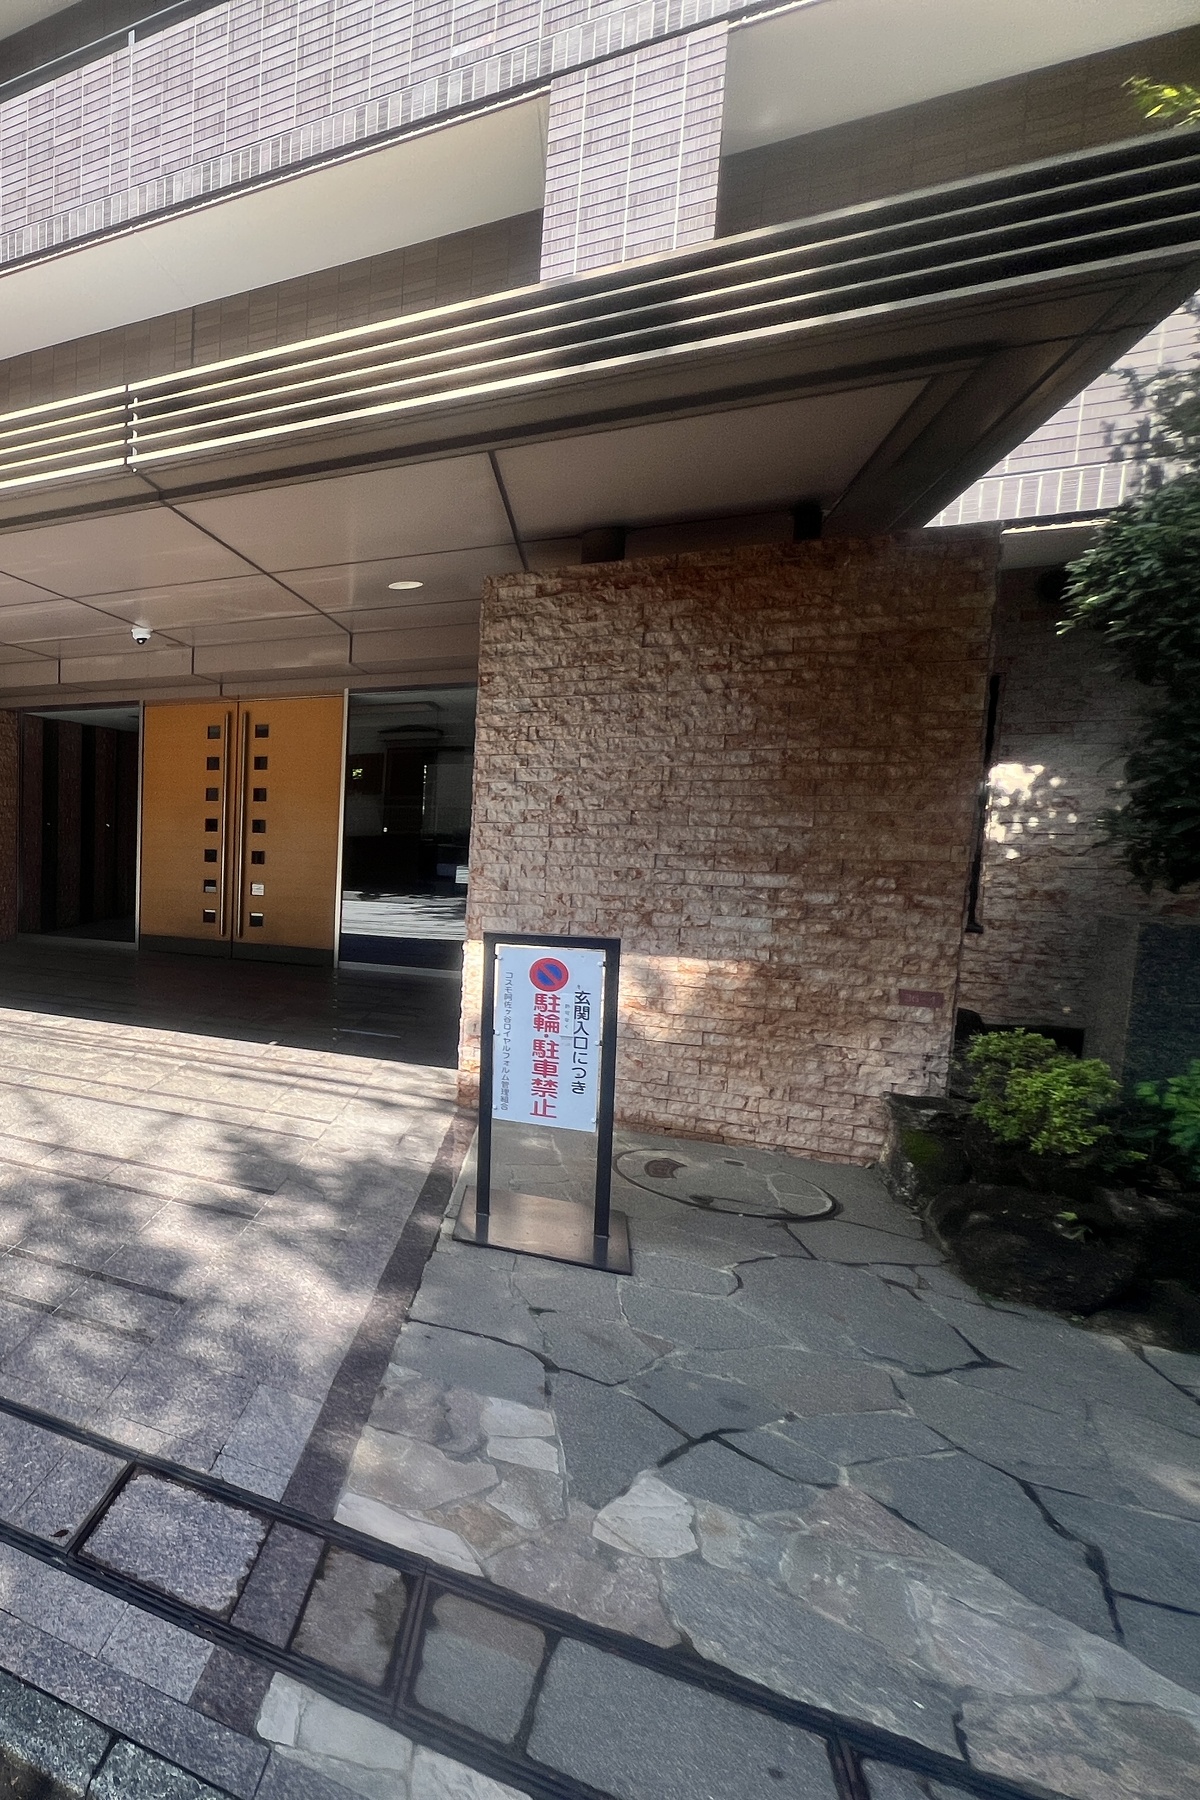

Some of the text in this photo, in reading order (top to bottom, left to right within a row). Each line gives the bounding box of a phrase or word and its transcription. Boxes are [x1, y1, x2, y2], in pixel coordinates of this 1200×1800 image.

[529, 993, 561, 1118] 駐輪・駐車禁止
[571, 990, 591, 1095] 玄関入口につき
